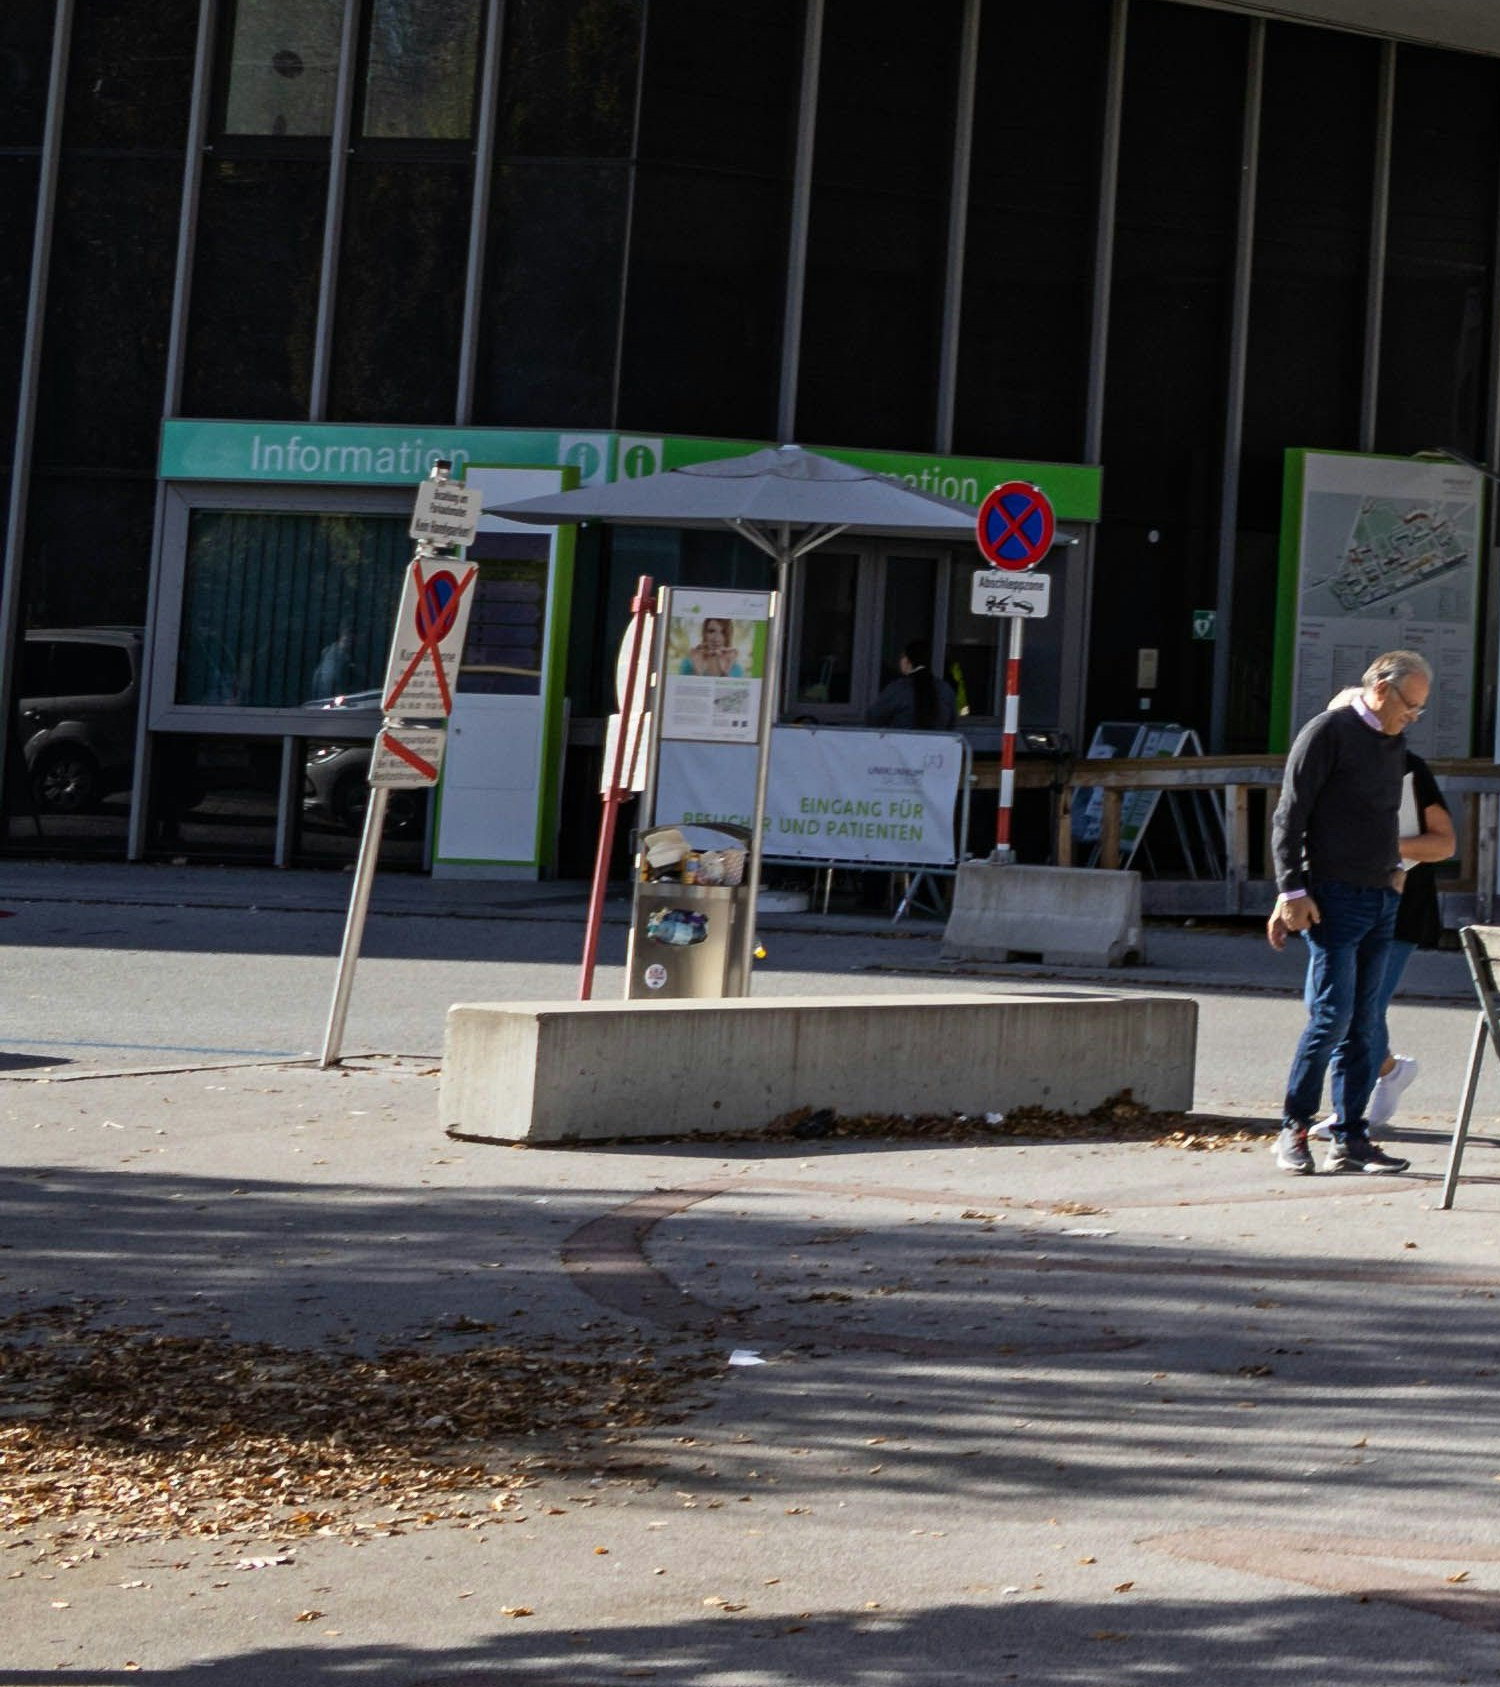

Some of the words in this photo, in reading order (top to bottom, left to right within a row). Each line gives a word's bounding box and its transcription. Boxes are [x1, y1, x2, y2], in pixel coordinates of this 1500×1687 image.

[250, 433, 471, 477] Information
[979, 576, 1045, 594] Abschleppzone
[799, 797, 883, 820] EINGANG
[889, 798, 924, 821] FÜR
[779, 818, 820, 836] UND
[826, 820, 923, 842] PATIENTEN
